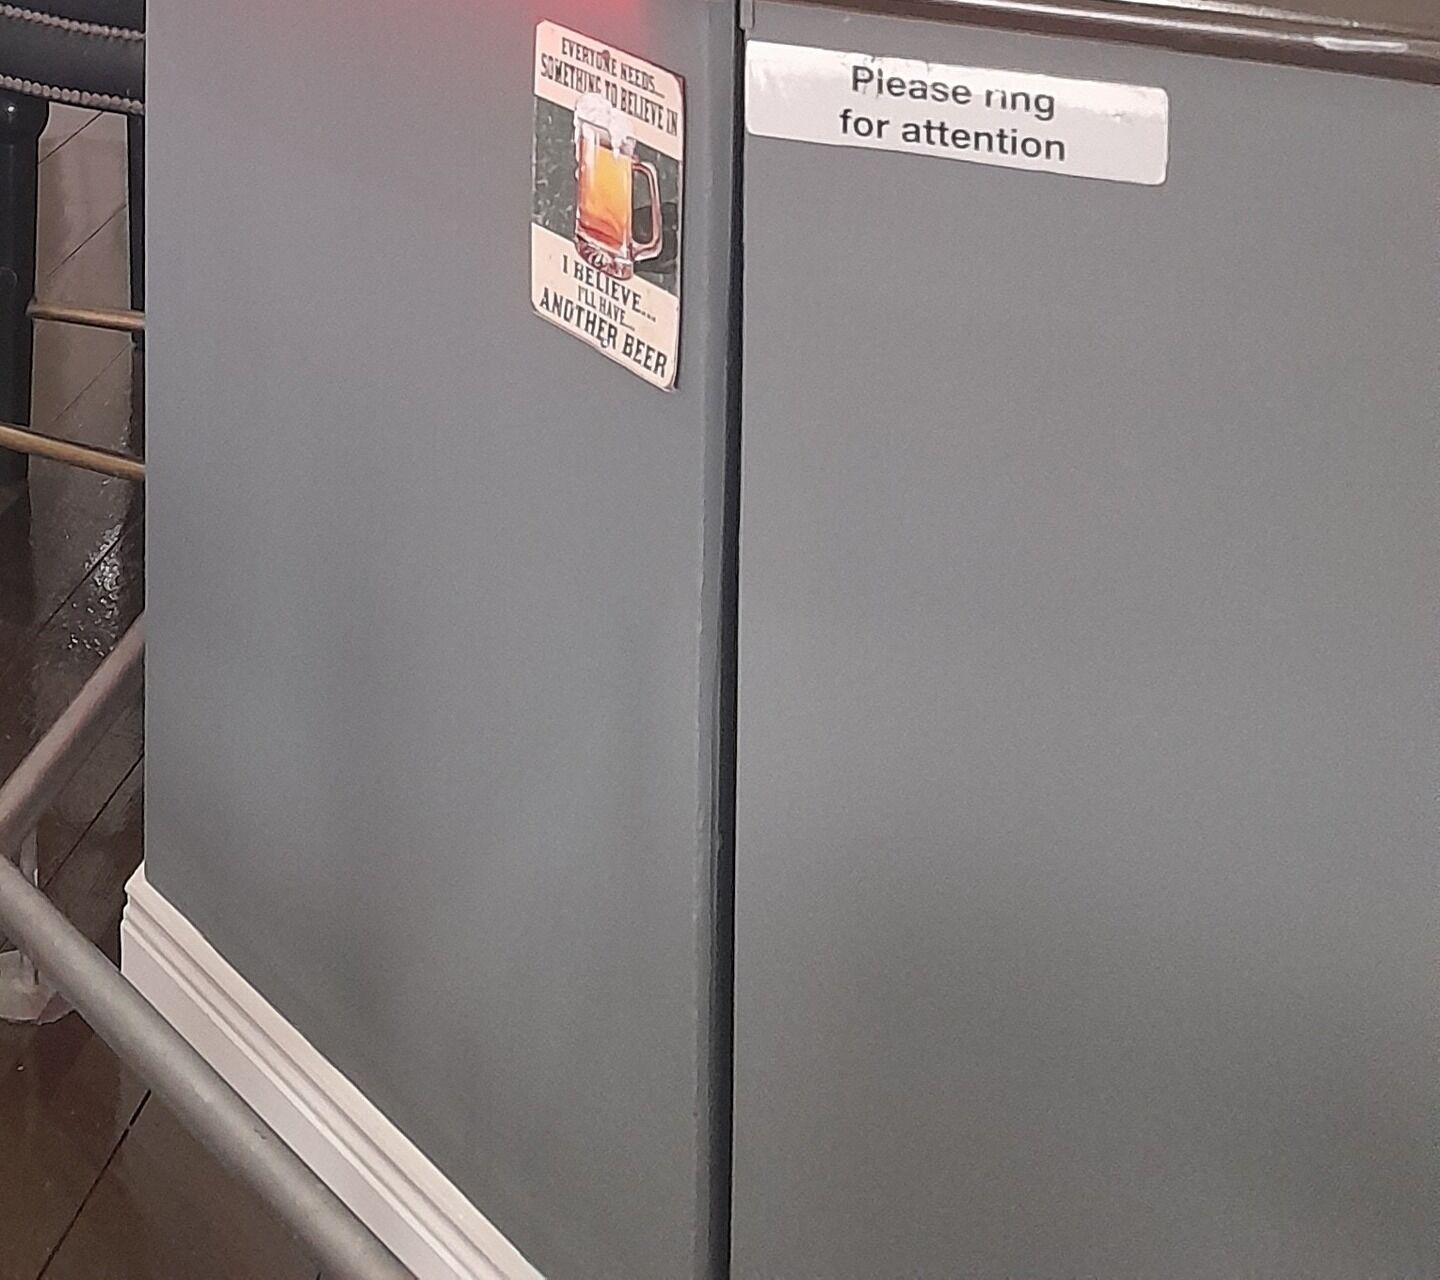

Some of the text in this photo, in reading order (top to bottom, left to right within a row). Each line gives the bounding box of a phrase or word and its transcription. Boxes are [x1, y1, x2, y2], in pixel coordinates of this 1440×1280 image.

[605, 80, 617, 108] TO
[621, 86, 663, 131] BELIEVE
[666, 108, 678, 136] IN
[852, 65, 1054, 121] Please ring
[840, 109, 1065, 161] for attention
[563, 255, 568, 274] I
[540, 287, 667, 378] ANOTHER BEER
